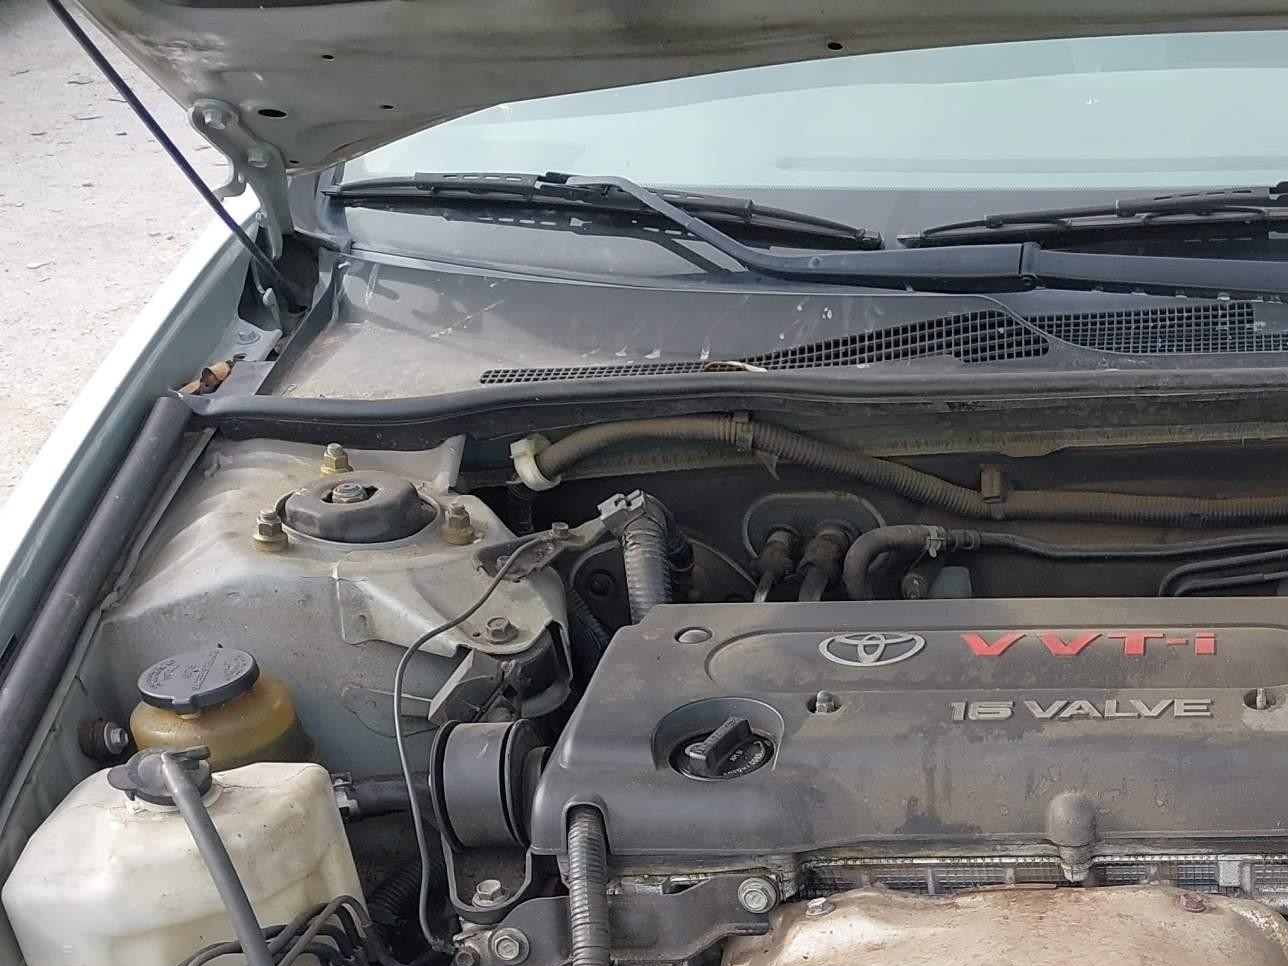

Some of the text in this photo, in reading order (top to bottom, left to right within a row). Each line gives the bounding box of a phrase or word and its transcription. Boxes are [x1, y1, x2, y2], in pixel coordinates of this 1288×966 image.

[960, 632, 1217, 657] VVT-i
[950, 699, 1214, 721] 16 VALVE
